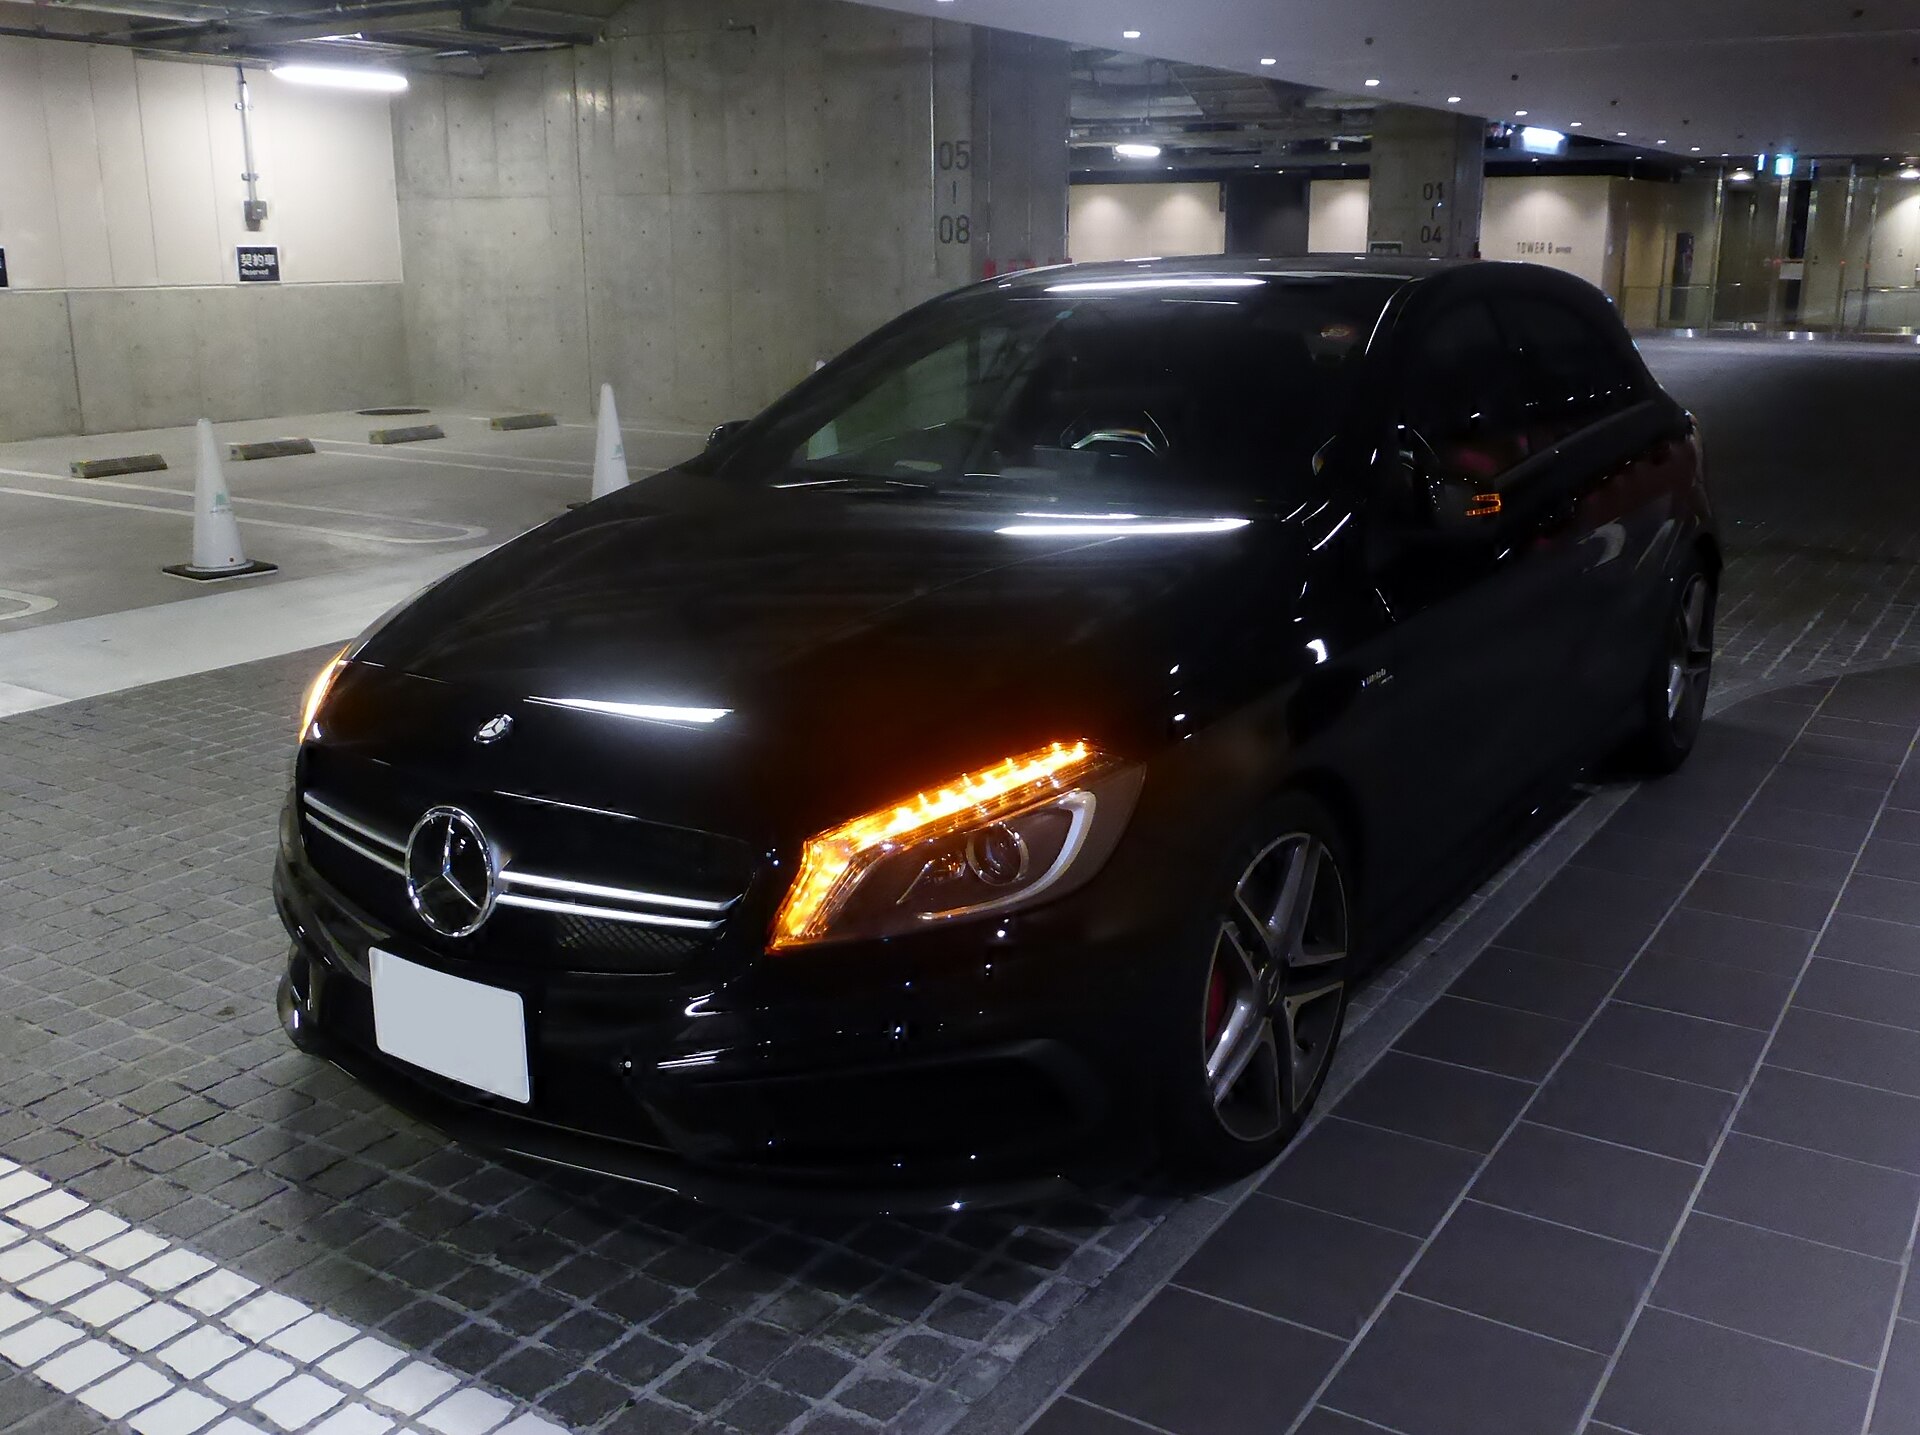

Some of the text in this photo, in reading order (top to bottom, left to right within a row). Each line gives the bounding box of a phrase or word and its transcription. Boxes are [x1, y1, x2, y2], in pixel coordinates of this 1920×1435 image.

[940, 141, 969, 170] 05
[1423, 182, 1442, 201] 01
[939, 214, 970, 244] 08
[1421, 225, 1442, 243] 04
[1517, 241, 1545, 254] TOWER
[240, 253, 276, 267] 契約車
